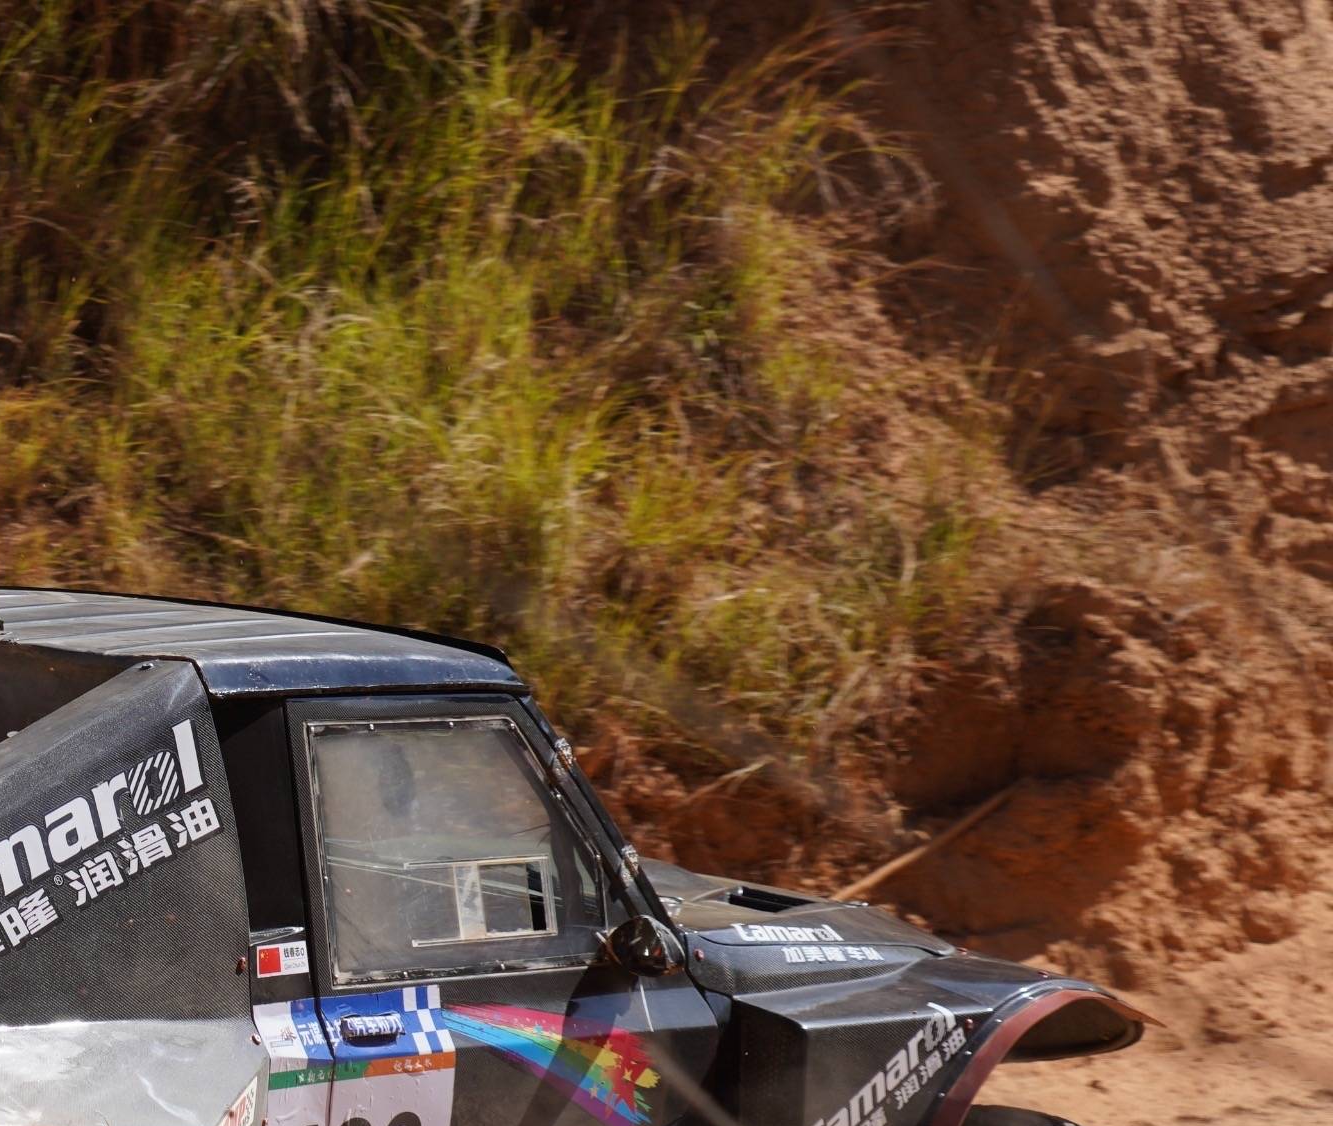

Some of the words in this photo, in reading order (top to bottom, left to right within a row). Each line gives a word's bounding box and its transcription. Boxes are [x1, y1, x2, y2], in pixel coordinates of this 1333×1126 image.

[63, 797, 222, 907] 润滑油
[893, 1026, 968, 1111] 润滑油
